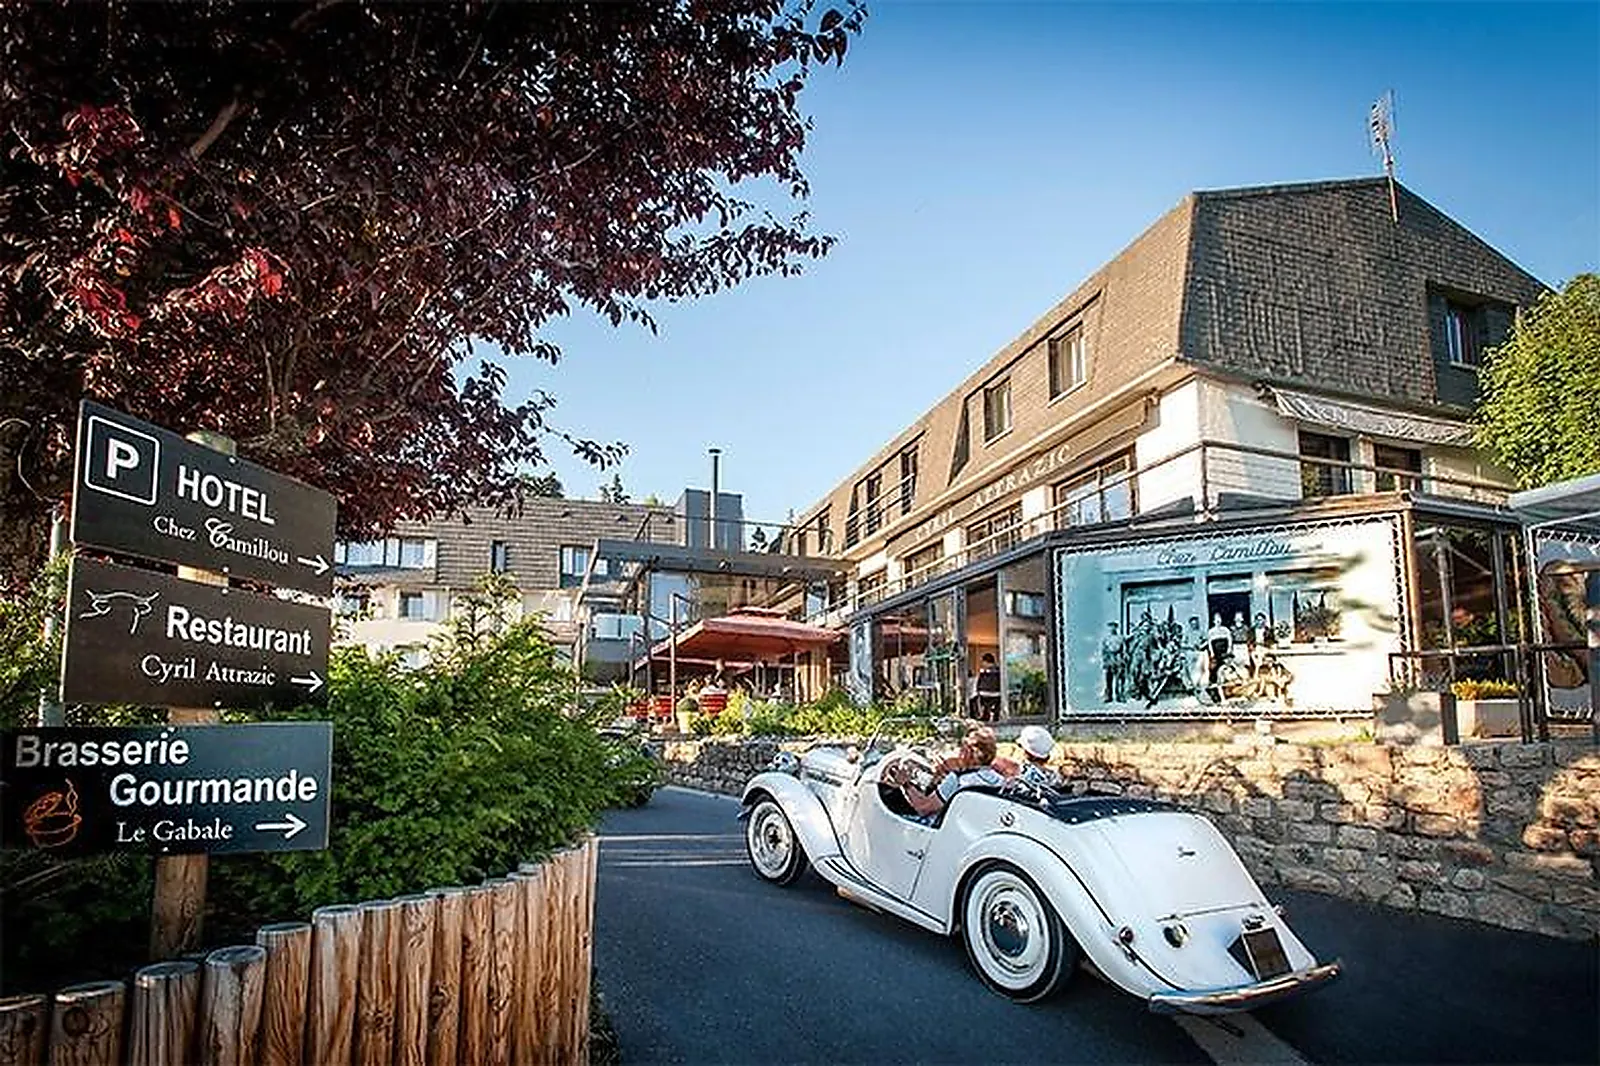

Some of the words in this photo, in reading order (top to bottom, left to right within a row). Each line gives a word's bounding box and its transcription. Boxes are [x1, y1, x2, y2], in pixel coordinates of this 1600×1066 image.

[177, 464, 275, 525] HOTEL
[153, 516, 197, 541] Chez
[205, 517, 290, 566] Camillou
[166, 605, 312, 656] Restaurant
[141, 654, 196, 685] Cyril
[207, 660, 277, 686] Attrazic
[15, 733, 189, 768] Brasserie
[109, 770, 318, 807] Gourmande
[117, 820, 146, 843] Le
[153, 820, 234, 843] Gabale
